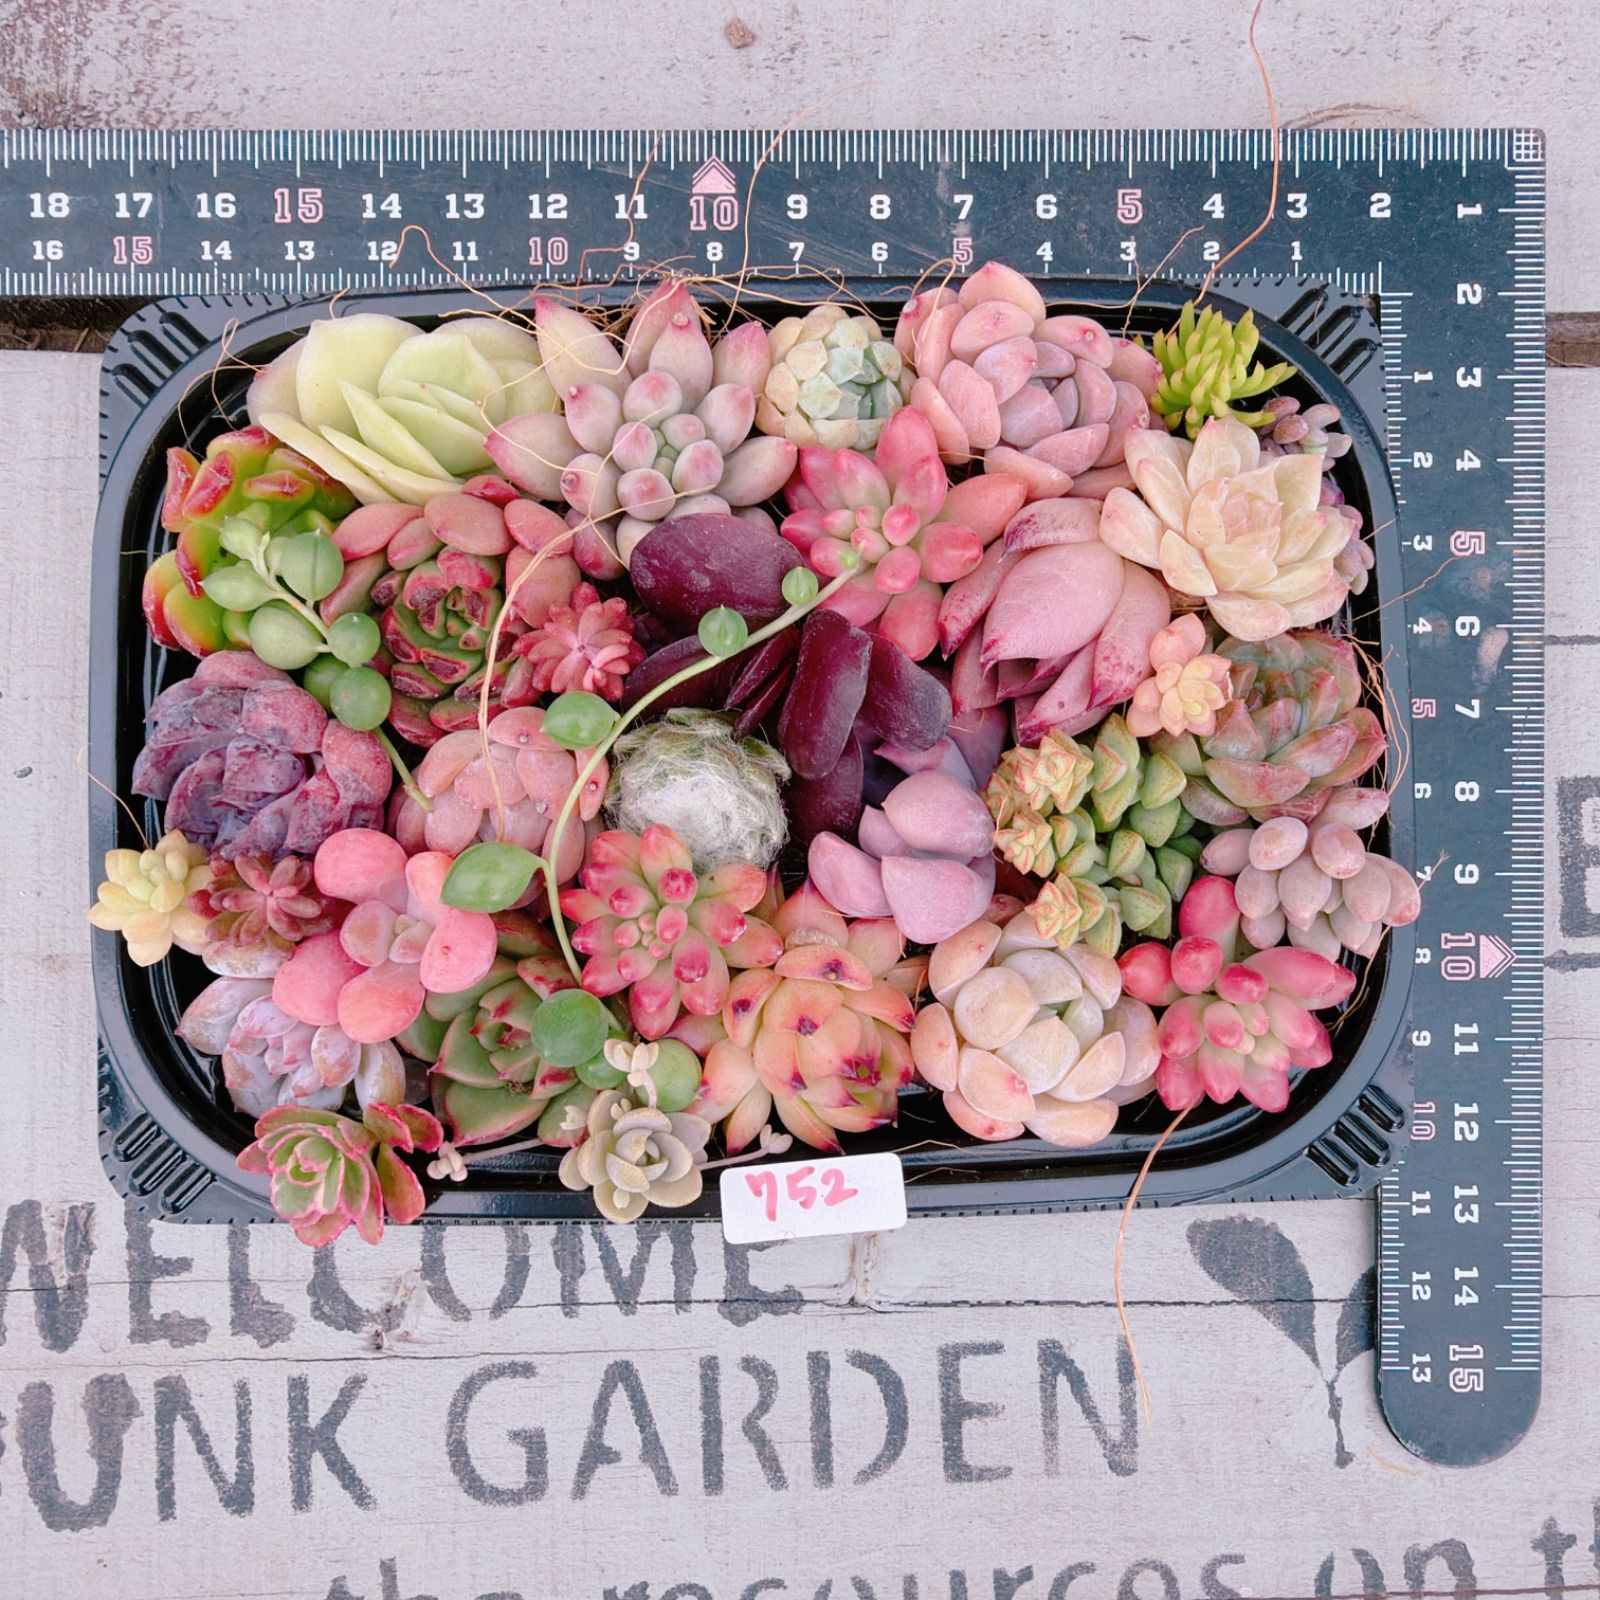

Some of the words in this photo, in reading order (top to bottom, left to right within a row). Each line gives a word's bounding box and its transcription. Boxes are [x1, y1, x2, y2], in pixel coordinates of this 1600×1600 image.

[29, 191, 73, 219] 18
[112, 192, 154, 219] 17
[196, 192, 237, 219] 16
[273, 187, 324, 224] 15
[361, 192, 403, 219] 14
[445, 193, 485, 219] 13
[528, 193, 568, 219] 12
[614, 193, 648, 220] 11
[689, 194, 739, 232] 10
[786, 193, 808, 220] 9
[869, 193, 891, 220] 8
[951, 193, 973, 220] 7
[1035, 193, 1058, 220] 6
[1116, 188, 1143, 225] 5
[1202, 193, 1225, 220] 4
[1286, 192, 1308, 219] 3
[1369, 192, 1392, 219] 2
[1457, 203, 1483, 219] 1
[32, 240, 64, 261] 16
[112, 236, 154, 266] 15
[200, 240, 233, 261] 14
[284, 240, 315, 261] 13
[367, 240, 399, 262] 12
[452, 240, 479, 262] 11
[528, 236, 569, 266] 10
[623, 241, 641, 262] 9
[706, 241, 724, 262] 8
[788, 241, 806, 262] 7
[871, 241, 889, 262] 6
[953, 237, 974, 266] 5
[1036, 241, 1054, 262] 4
[1119, 240, 1137, 262] 3
[1203, 240, 1221, 262] 2
[1291, 240, 1303, 261] 1
[1456, 283, 1483, 305] 2
[1413, 371, 1434, 384] 1
[1456, 366, 1482, 388] 3
[1413, 451, 1434, 469] 2
[1455, 449, 1482, 472] 4
[1413, 534, 1433, 552] 3
[1449, 530, 1486, 558] 5
[1412, 616, 1433, 635] 4
[1454, 615, 1481, 637] 6
[1411, 697, 1437, 719] 5
[1454, 698, 1481, 719] 7
[1454, 781, 1480, 802] 8
[1453, 863, 1480, 885] 9
[1440, 932, 1476, 981] 10
[1411, 1030, 1432, 1047] 9
[1453, 1022, 1480, 1056] 11
[1410, 1101, 1436, 1141] 10
[1453, 1102, 1480, 1142] 12
[745, 1166, 858, 1221] 752
[1411, 1190, 1432, 1217] 11
[1453, 1184, 1480, 1224] 13
[1411, 1271, 1432, 1301] 12
[1454, 1266, 1480, 1307] 14
[1411, 1353, 1432, 1383] 13
[1448, 1344, 1484, 1393] 15
[0, 1372, 377, 1532] UNK
[446, 1338, 1140, 1506] GARDEN
